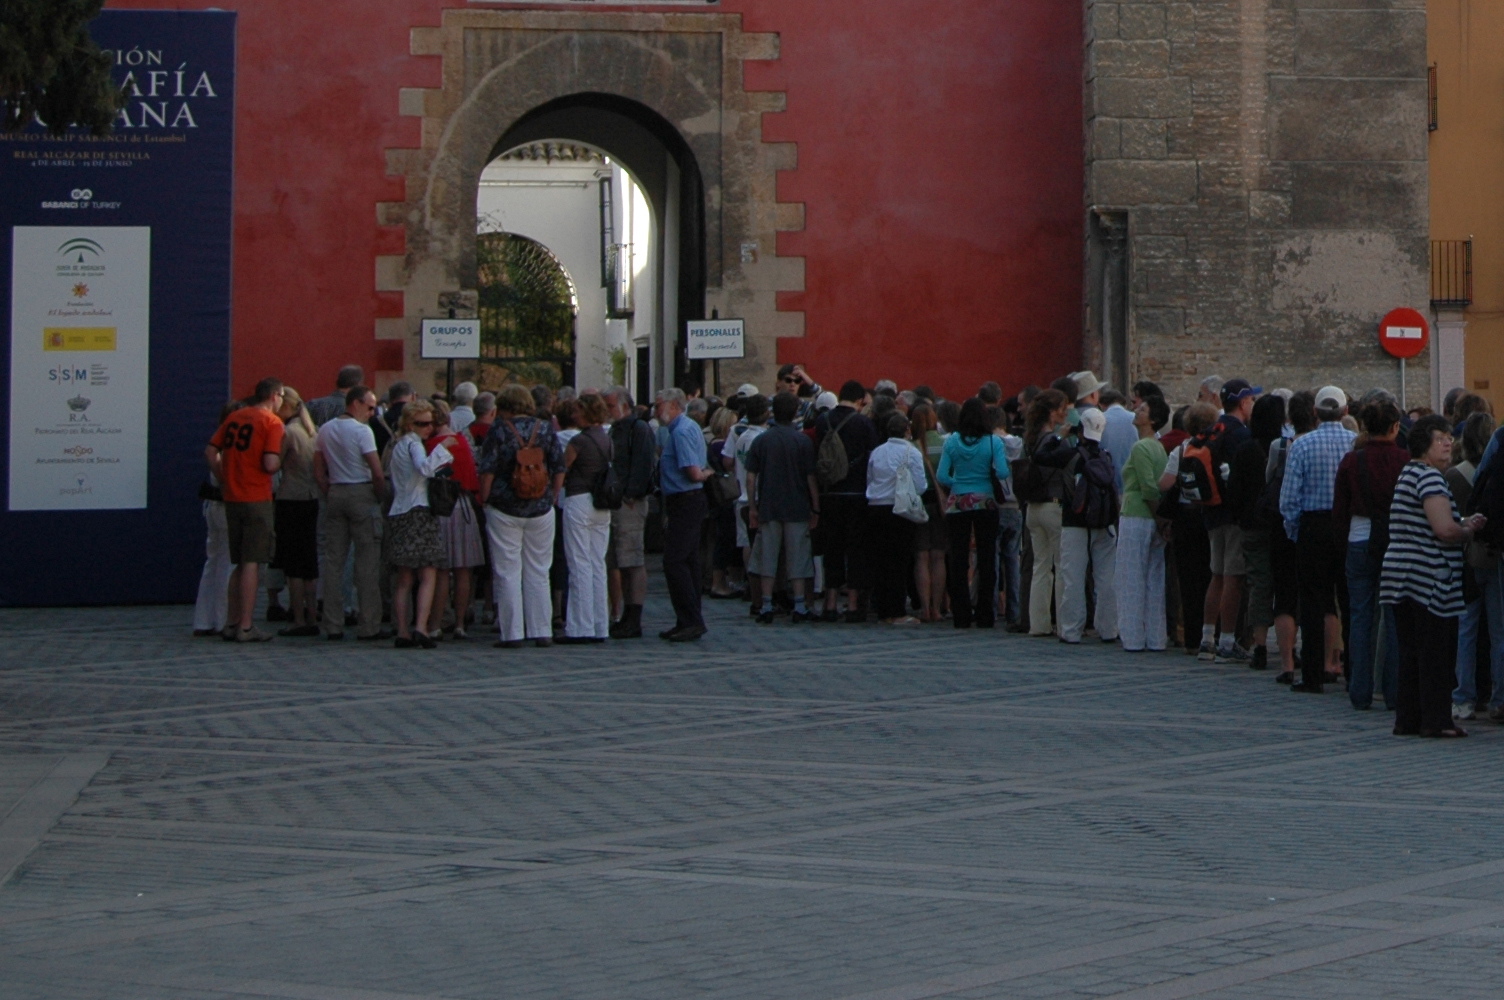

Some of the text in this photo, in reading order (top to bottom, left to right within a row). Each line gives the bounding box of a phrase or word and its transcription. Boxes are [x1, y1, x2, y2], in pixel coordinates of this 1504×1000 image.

[108, 151, 150, 160] SEVILLA
[430, 326, 473, 335] GRUPOS
[690, 328, 741, 337] PERSONALES
[223, 420, 254, 451] 69
